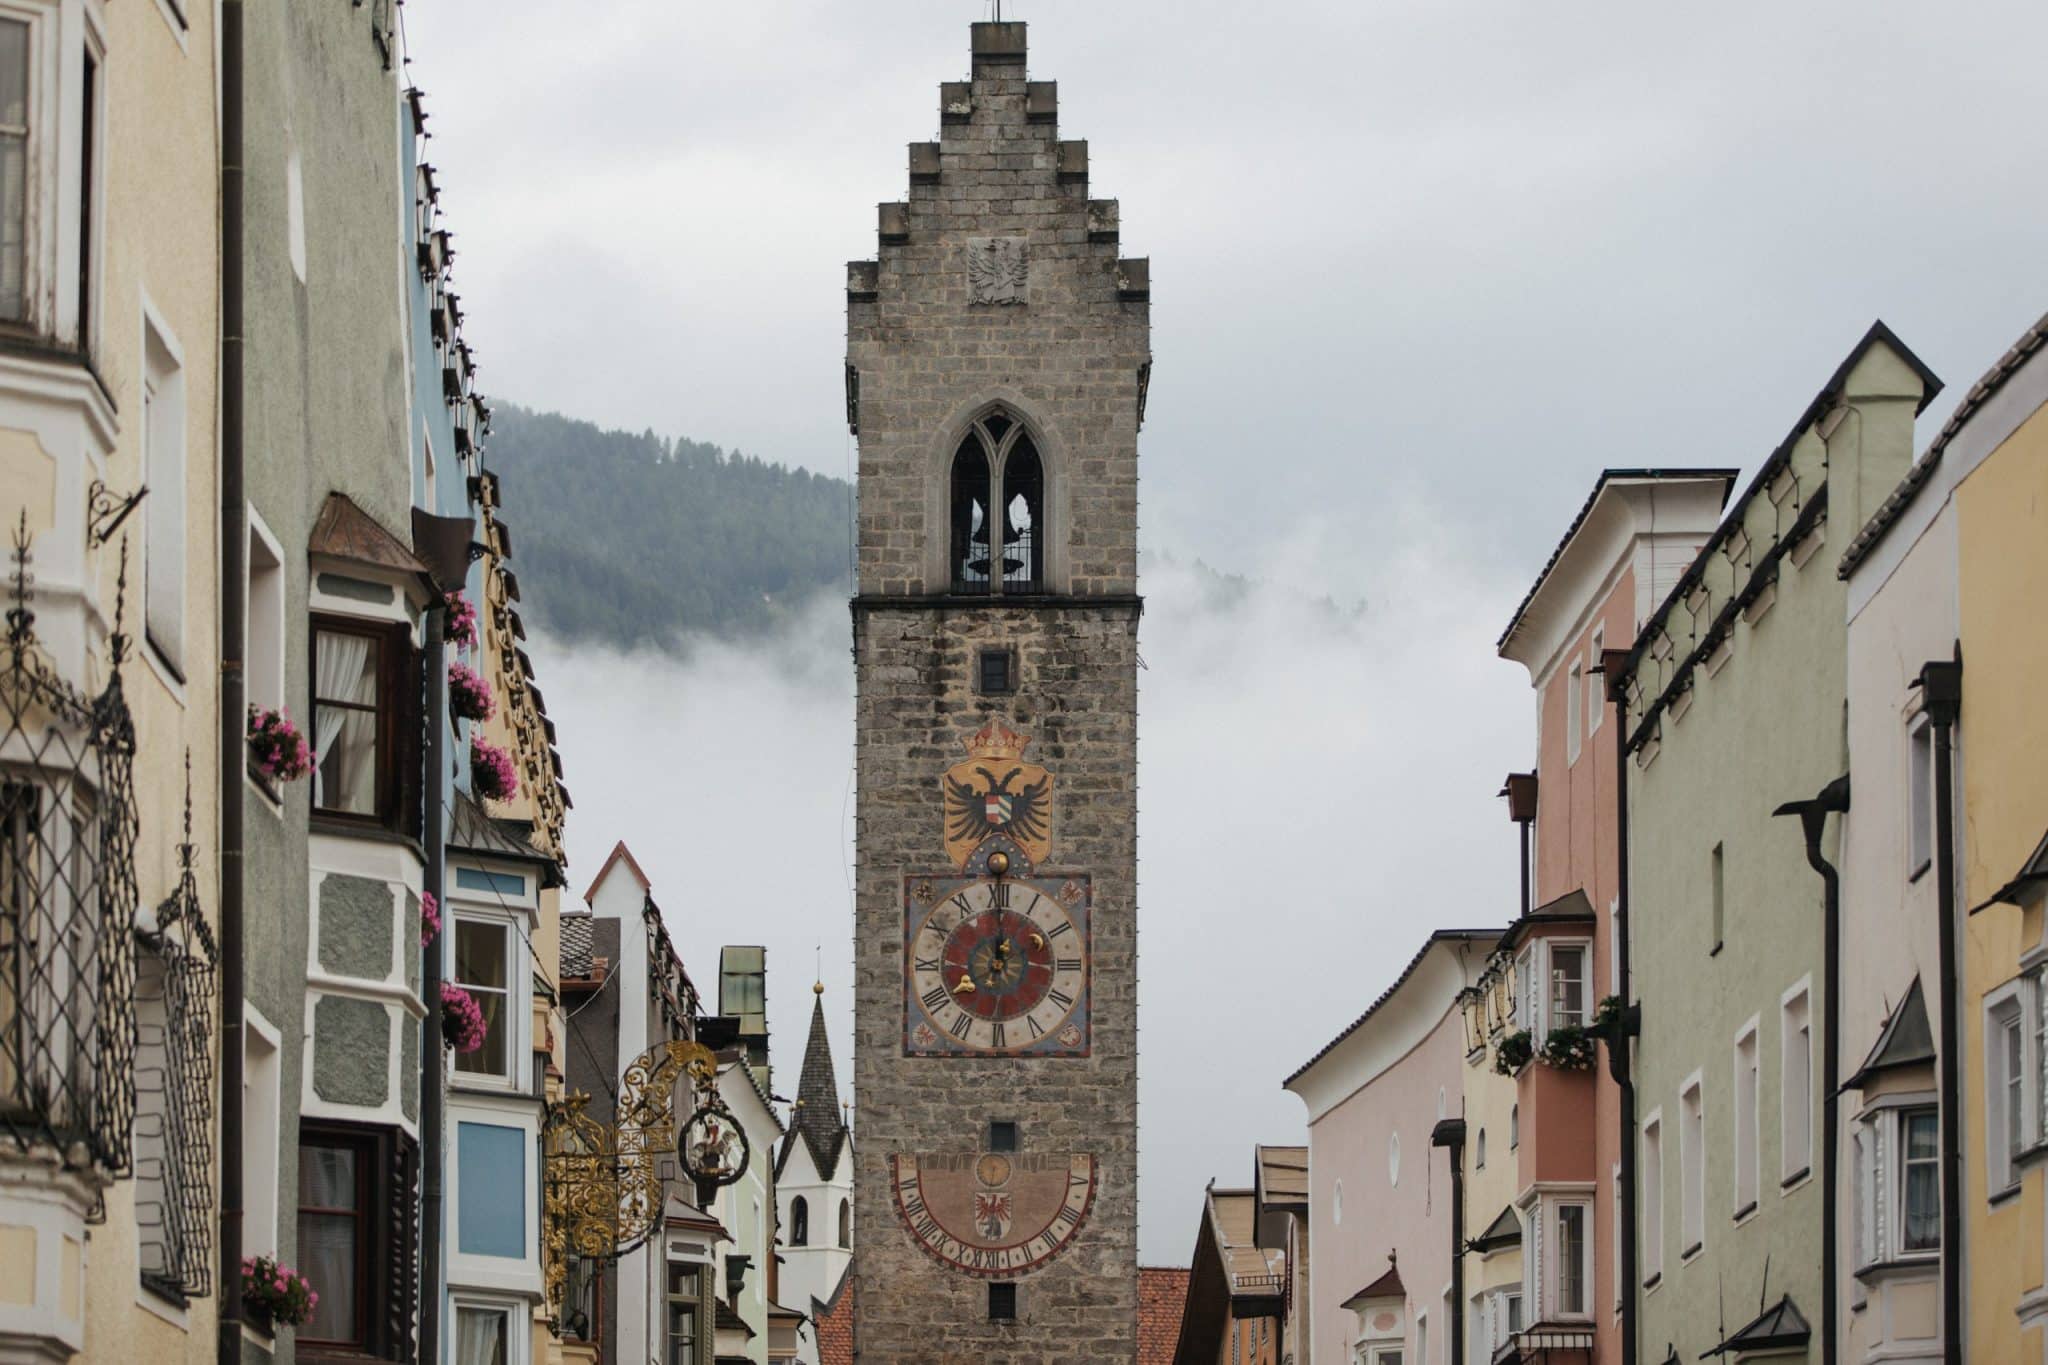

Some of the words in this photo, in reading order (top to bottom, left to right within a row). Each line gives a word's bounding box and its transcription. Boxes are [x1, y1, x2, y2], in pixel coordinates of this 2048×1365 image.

[950, 892, 972, 918] XI
[1027, 893, 1040, 915] I
[925, 918, 950, 941] X
[1048, 921, 1073, 939] II
[915, 956, 939, 972] IX
[1057, 958, 1082, 972] III
[922, 985, 950, 1016] VIII
[1048, 989, 1074, 1013] IV
[950, 1011, 973, 1041] VII
[992, 1023, 1006, 1047] VI
[1027, 1015, 1045, 1039] V
[900, 1178, 917, 1190] VI
[1070, 1175, 1088, 1187] V
[905, 1197, 924, 1217] VII
[1061, 1204, 1081, 1226] IIII
[916, 1214, 938, 1239] VIII
[935, 1232, 952, 1252] IX
[1041, 1229, 1059, 1249] III
[954, 1244, 968, 1263] X
[985, 1250, 999, 1269] XII
[1022, 1243, 1034, 1263] II
